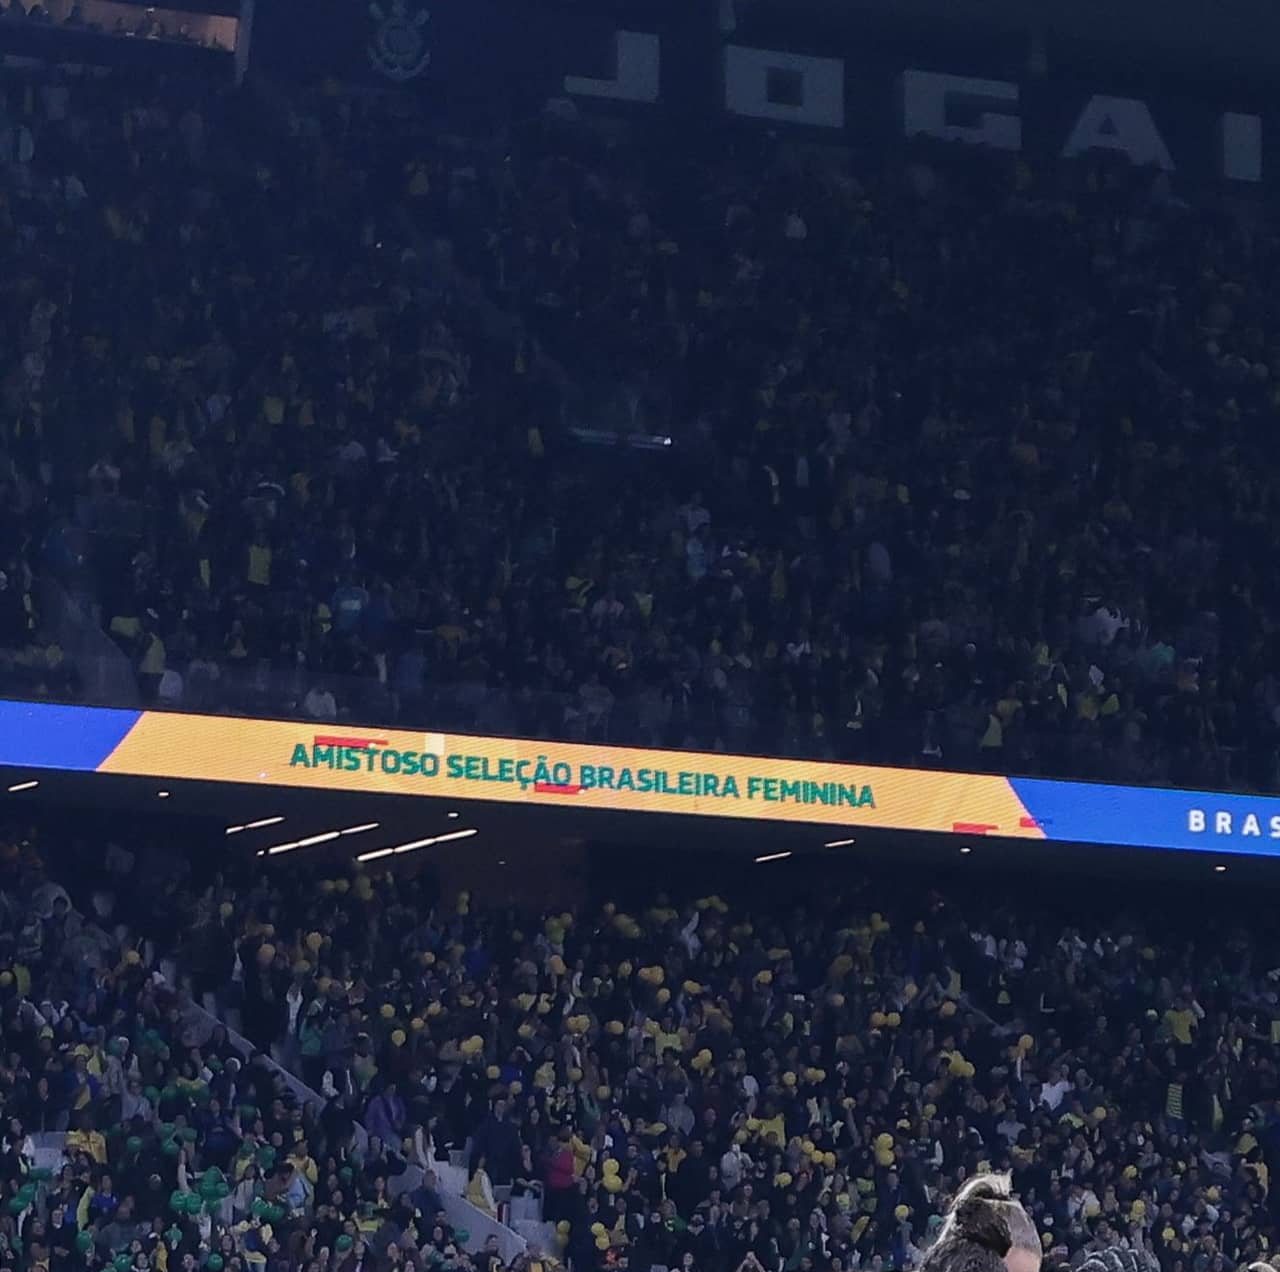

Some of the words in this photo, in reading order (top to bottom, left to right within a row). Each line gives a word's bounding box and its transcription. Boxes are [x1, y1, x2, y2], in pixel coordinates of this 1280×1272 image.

[289, 743, 439, 778] AMISTOSO
[446, 752, 571, 791] SELEÇÃO
[580, 765, 741, 799] BRASILEIRA
[747, 776, 876, 809] FEMININA
